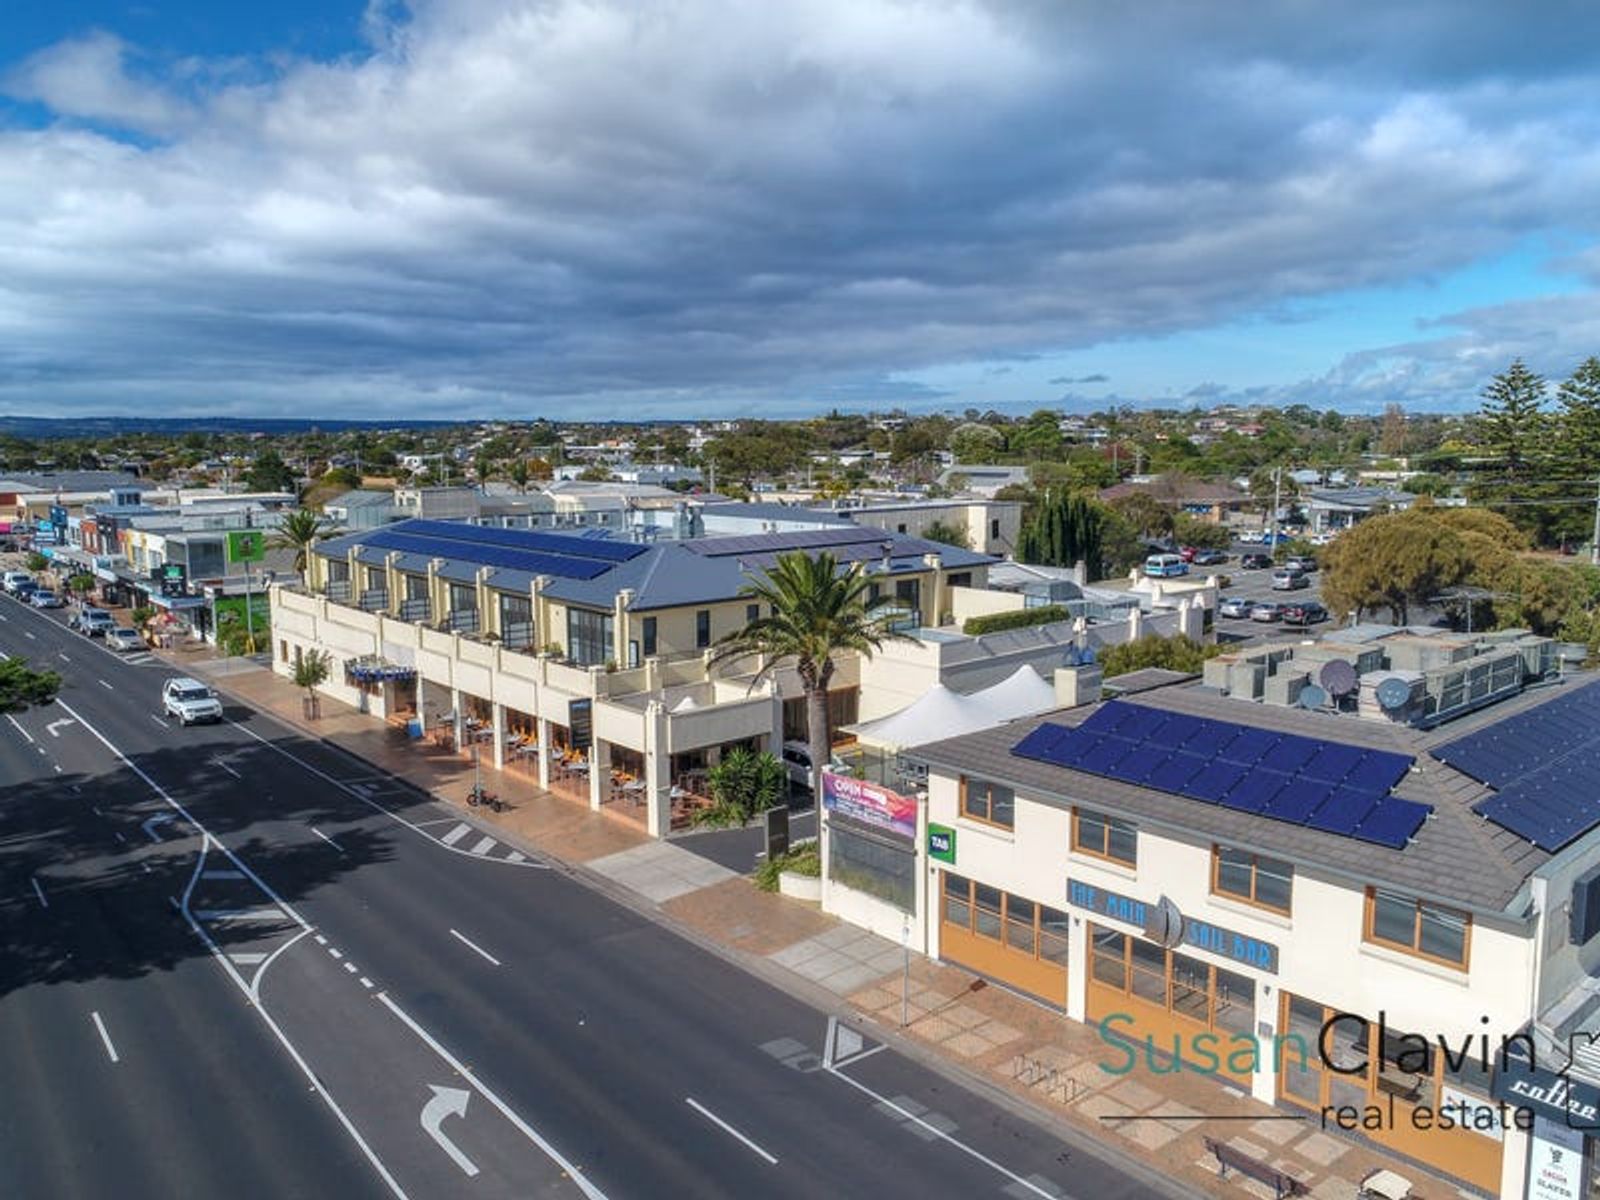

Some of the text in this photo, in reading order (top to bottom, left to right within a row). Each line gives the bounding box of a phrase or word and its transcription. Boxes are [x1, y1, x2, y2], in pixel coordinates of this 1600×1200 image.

[931, 835, 949, 851] TAB
[1071, 881, 1270, 970] THE MAIN SAIL BAR
[1508, 1080, 1597, 1121] coffee
